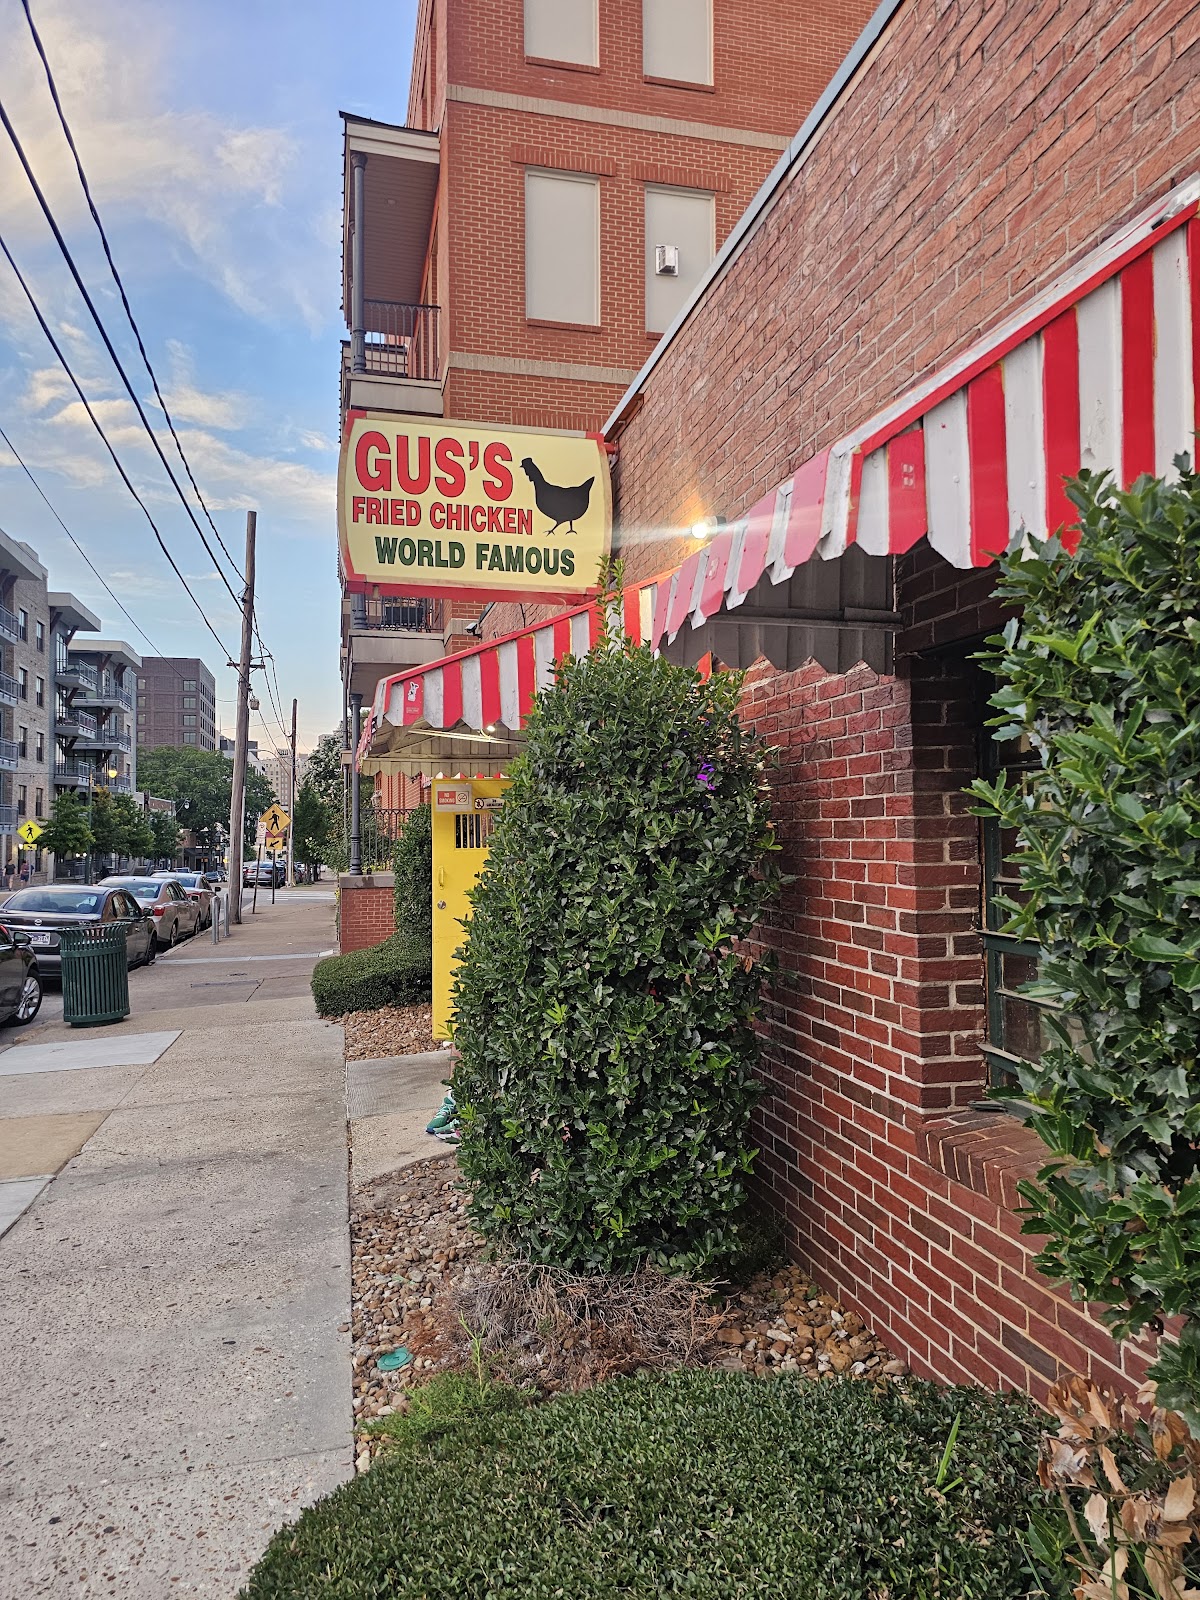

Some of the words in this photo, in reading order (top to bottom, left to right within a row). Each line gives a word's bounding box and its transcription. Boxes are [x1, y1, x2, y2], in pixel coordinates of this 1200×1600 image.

[355, 430, 513, 501] GUS'S
[352, 496, 421, 526] FRIED
[429, 502, 533, 535] CHICKEN
[375, 536, 466, 568] WORLD
[476, 542, 575, 576] FAMOUS
